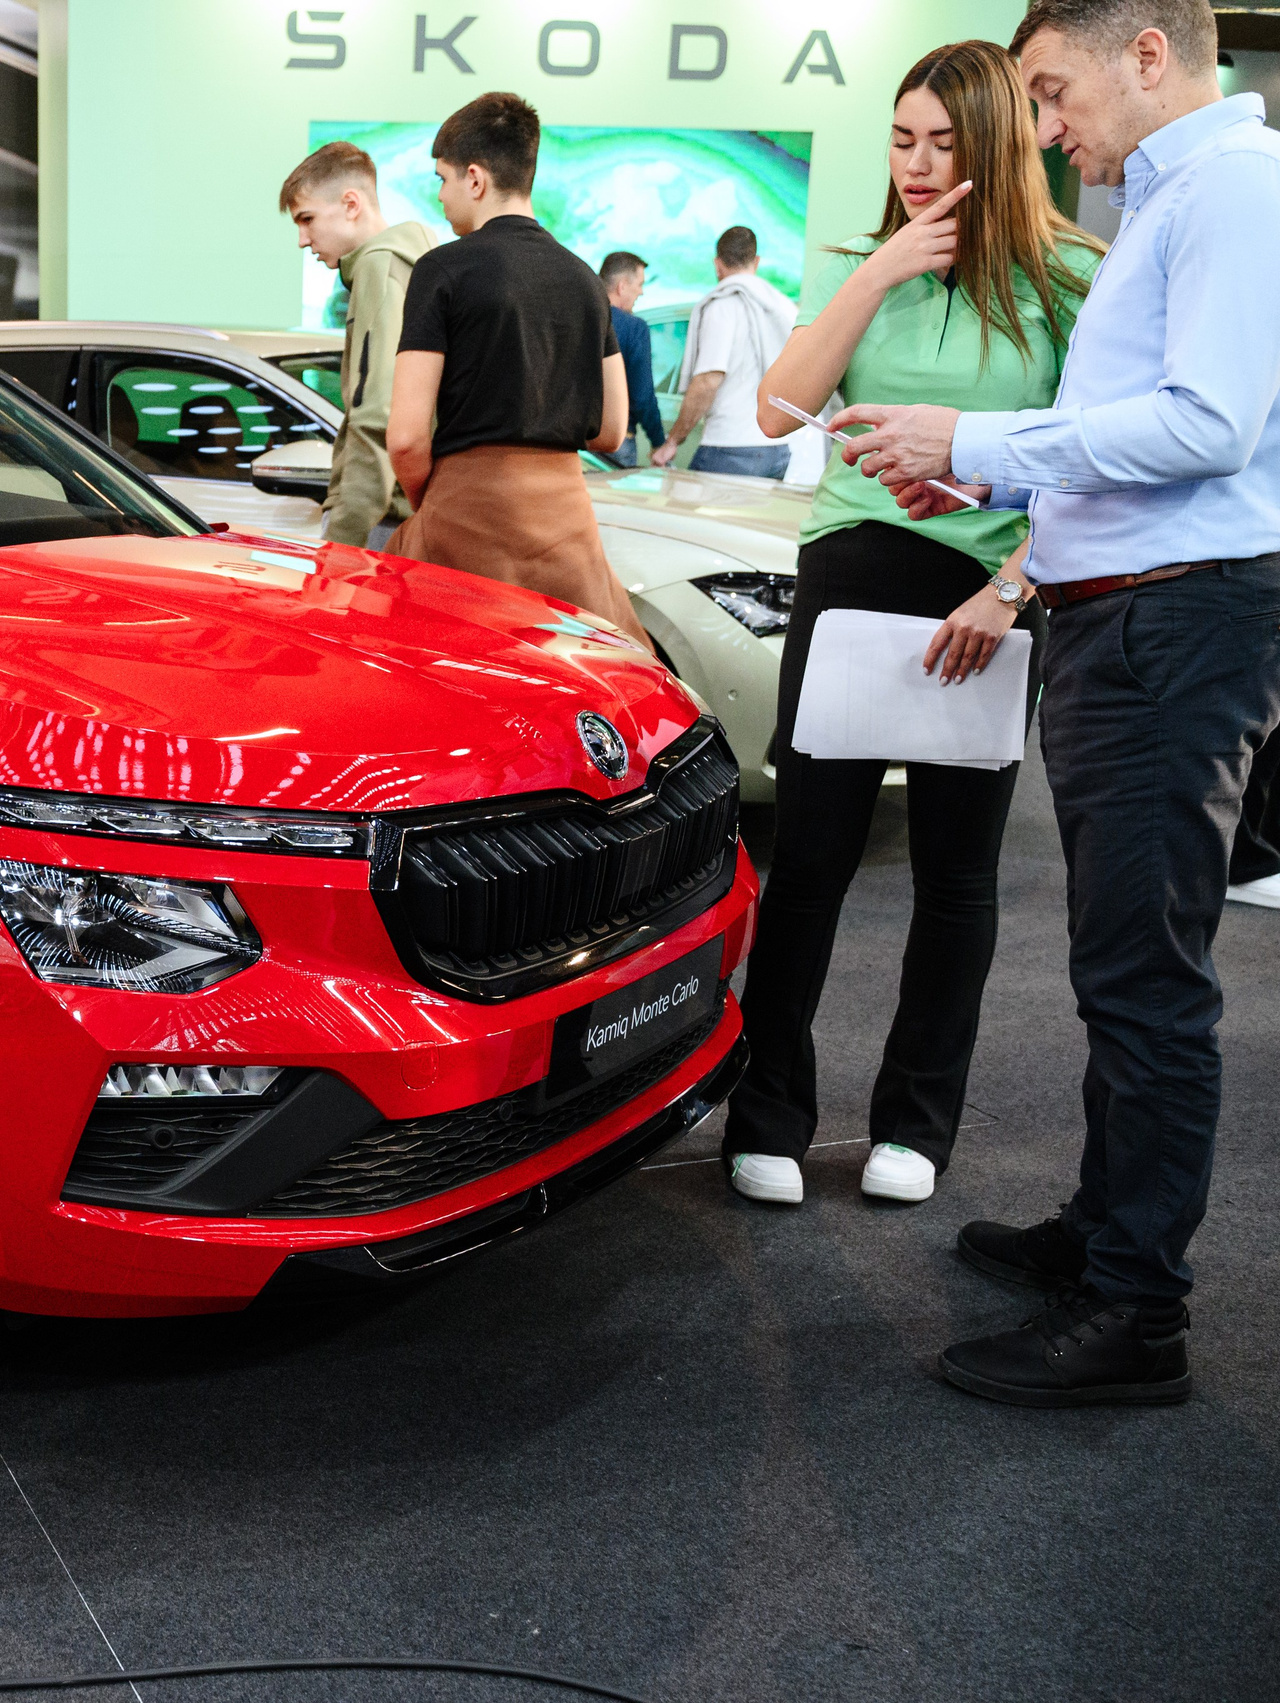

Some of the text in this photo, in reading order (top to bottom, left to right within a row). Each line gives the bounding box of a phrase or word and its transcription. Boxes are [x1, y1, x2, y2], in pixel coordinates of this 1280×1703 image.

[586, 975, 699, 1051] Kamiq Monte Carlo
